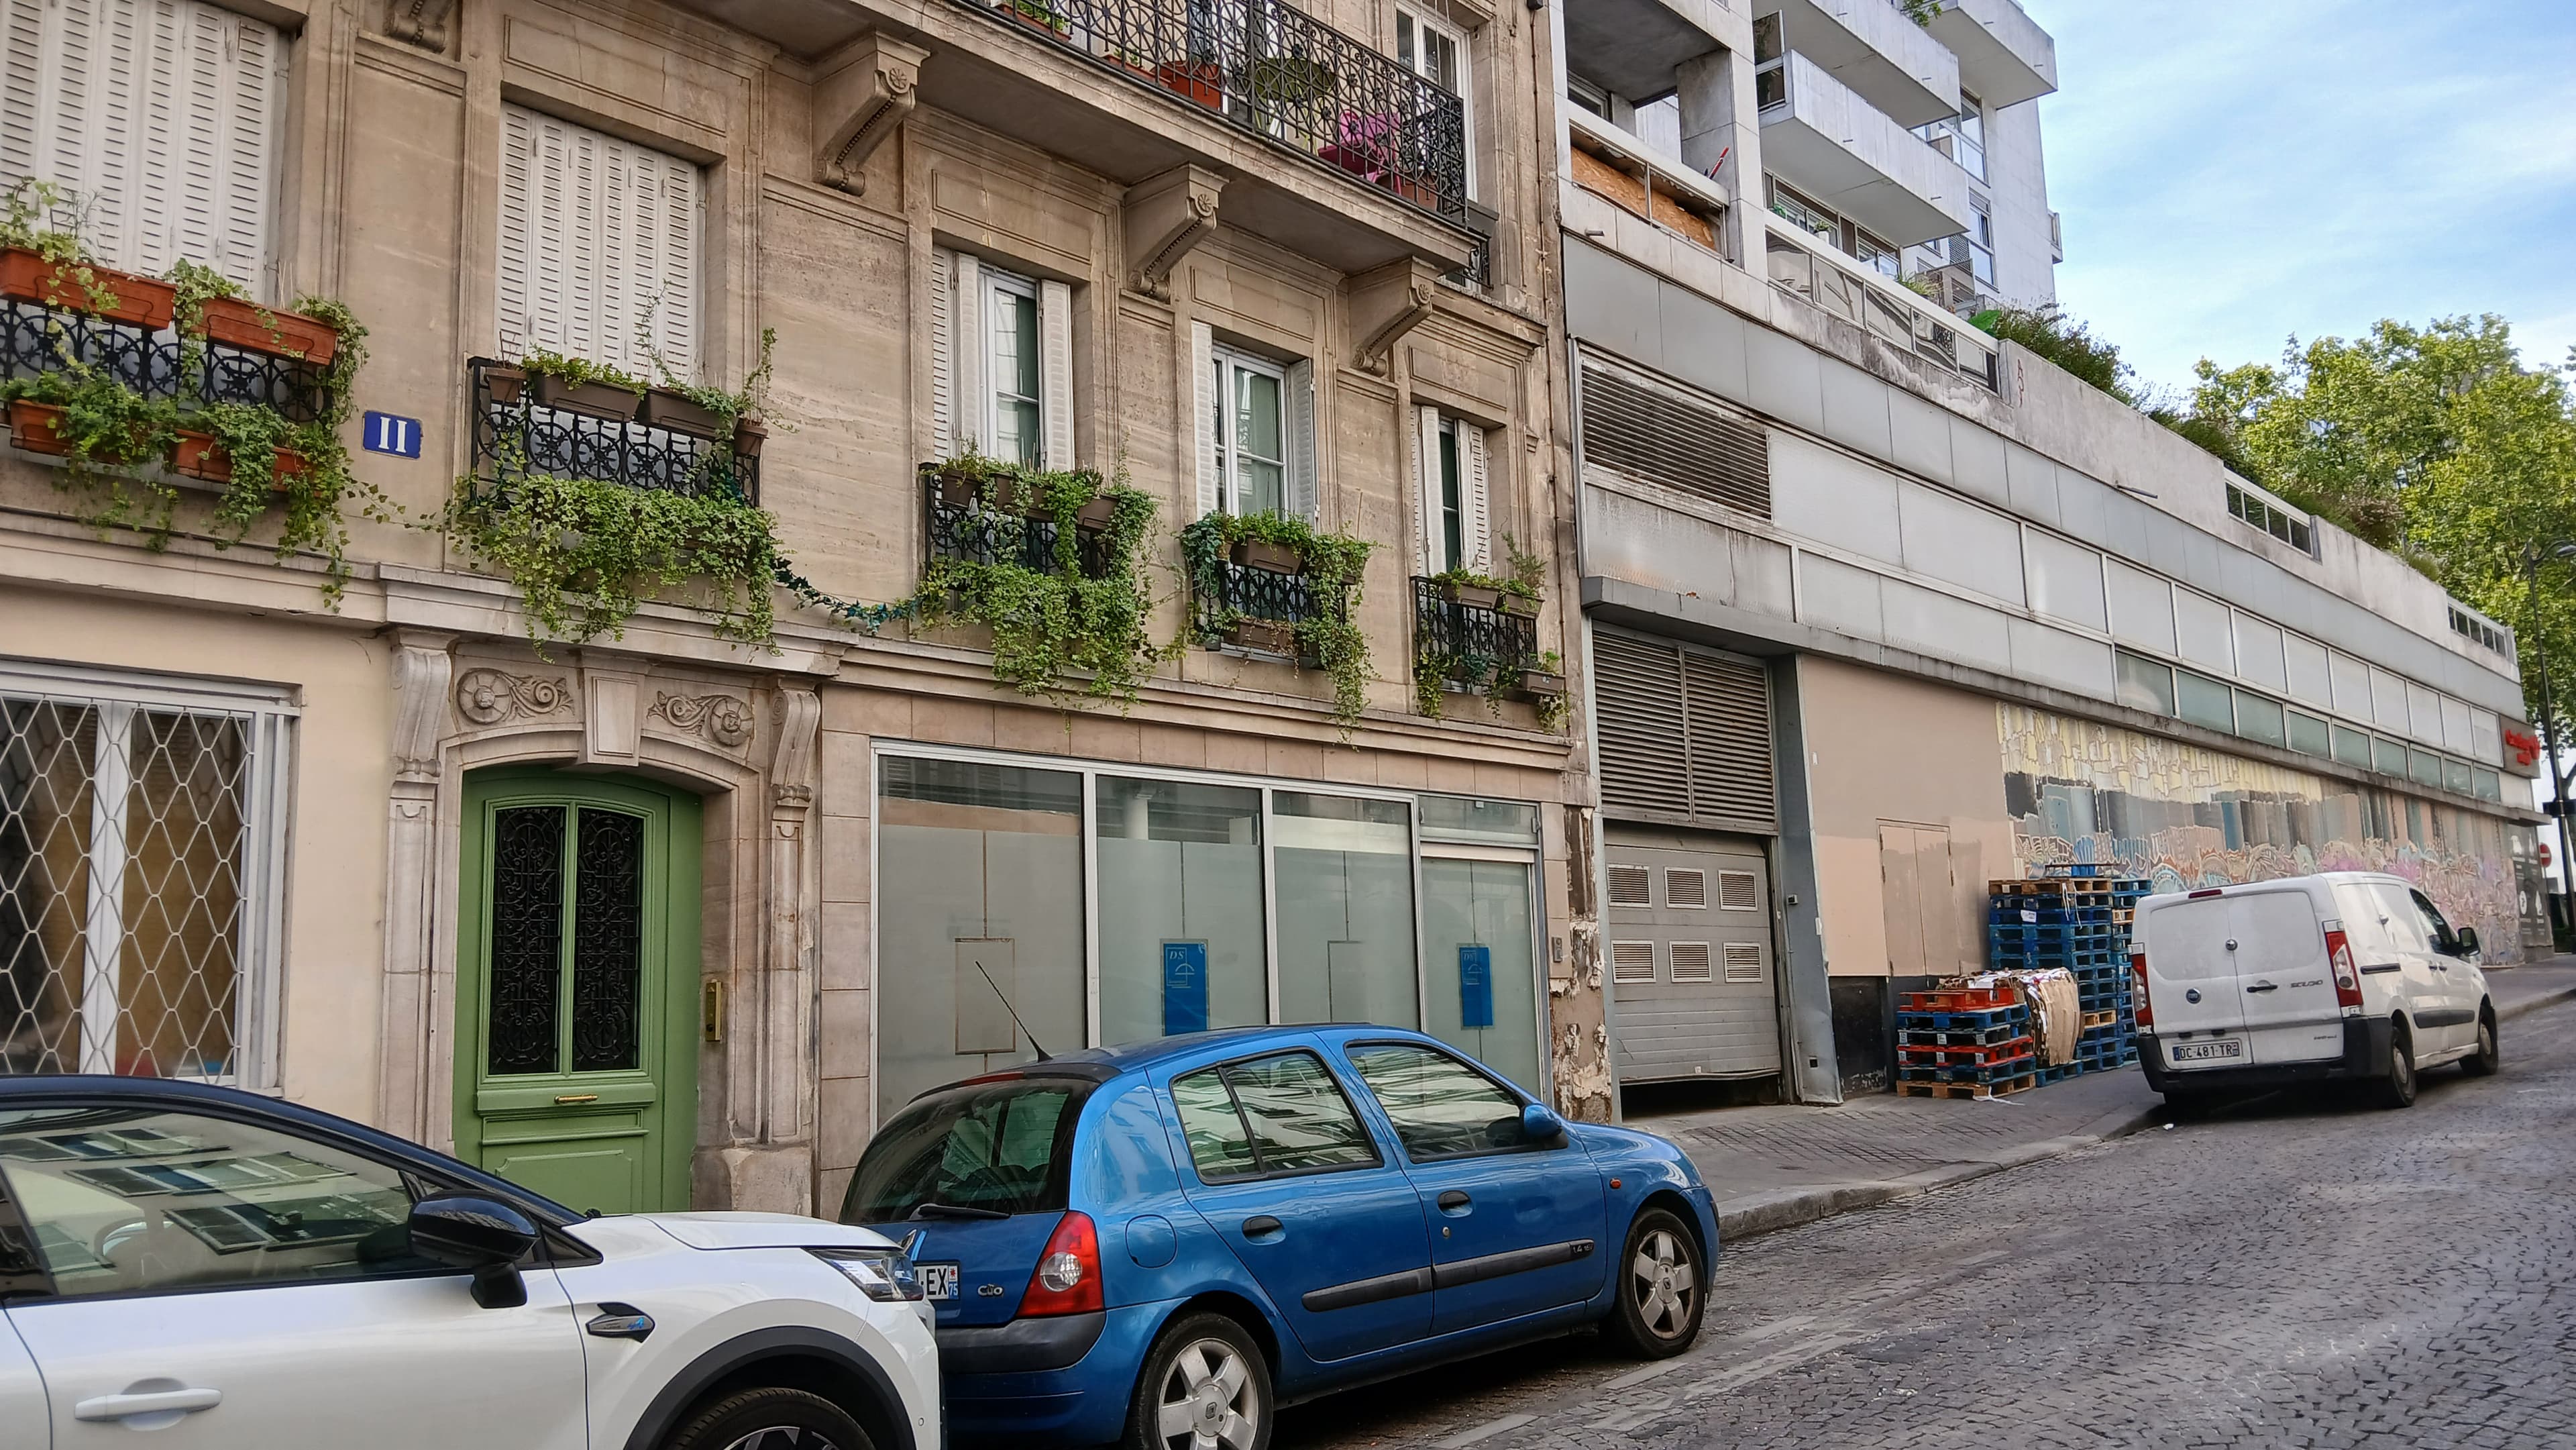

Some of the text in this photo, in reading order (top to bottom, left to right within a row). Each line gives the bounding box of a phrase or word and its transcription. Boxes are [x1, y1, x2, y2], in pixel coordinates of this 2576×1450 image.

[378, 417, 407, 452] 11
[1169, 950, 1185, 960] DS
[949, 1283, 959, 1296] 75
